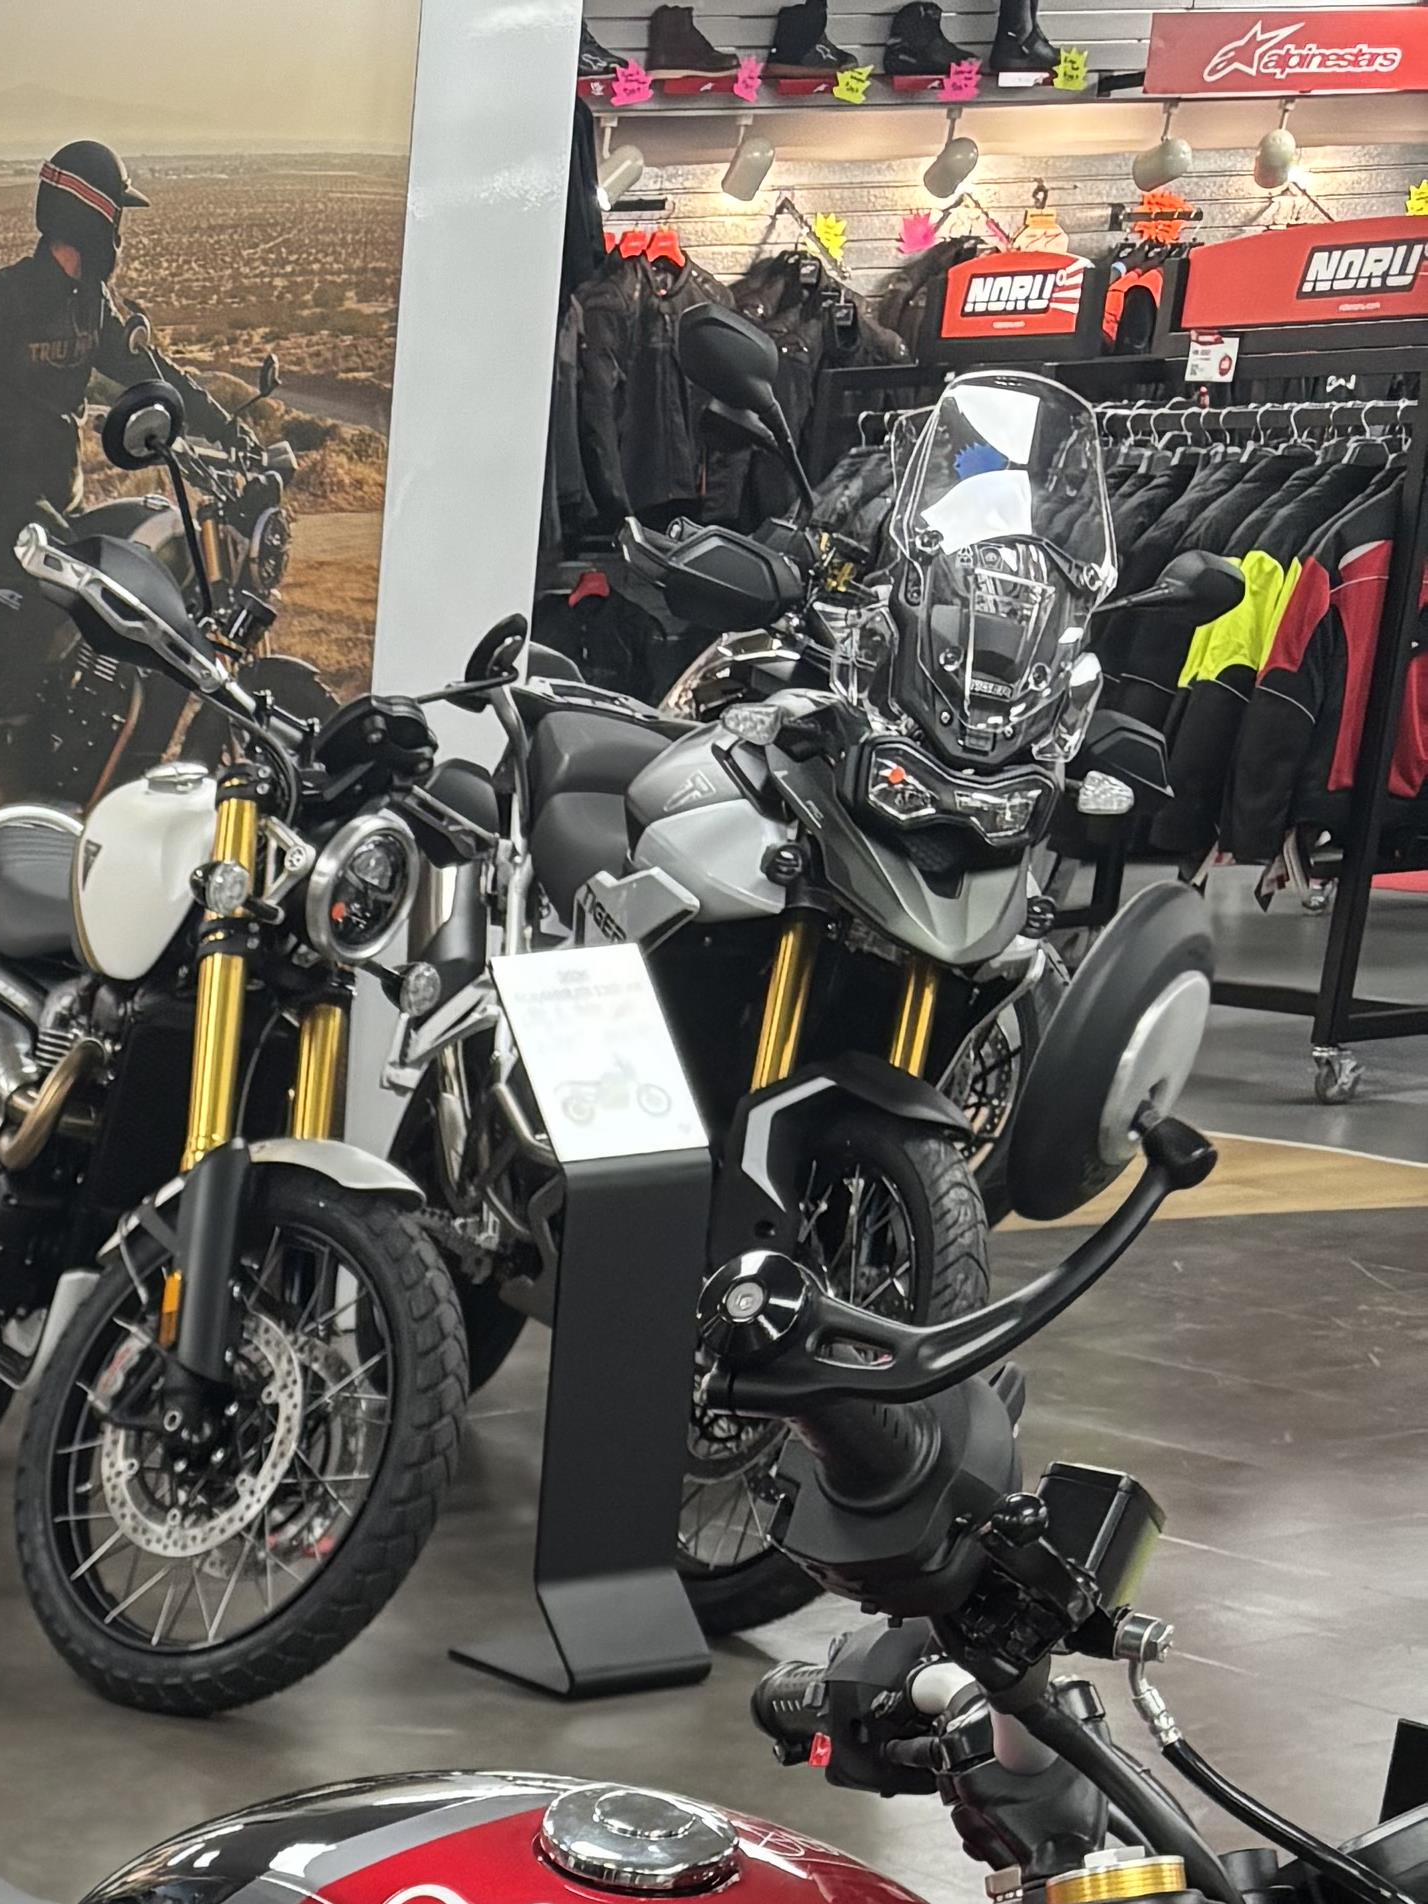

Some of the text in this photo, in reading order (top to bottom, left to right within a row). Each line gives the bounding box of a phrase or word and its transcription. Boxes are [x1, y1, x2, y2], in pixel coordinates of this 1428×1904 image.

[1259, 43, 1402, 79] alpinestars
[1301, 244, 1424, 293] NORU
[964, 273, 1056, 313] NORU
